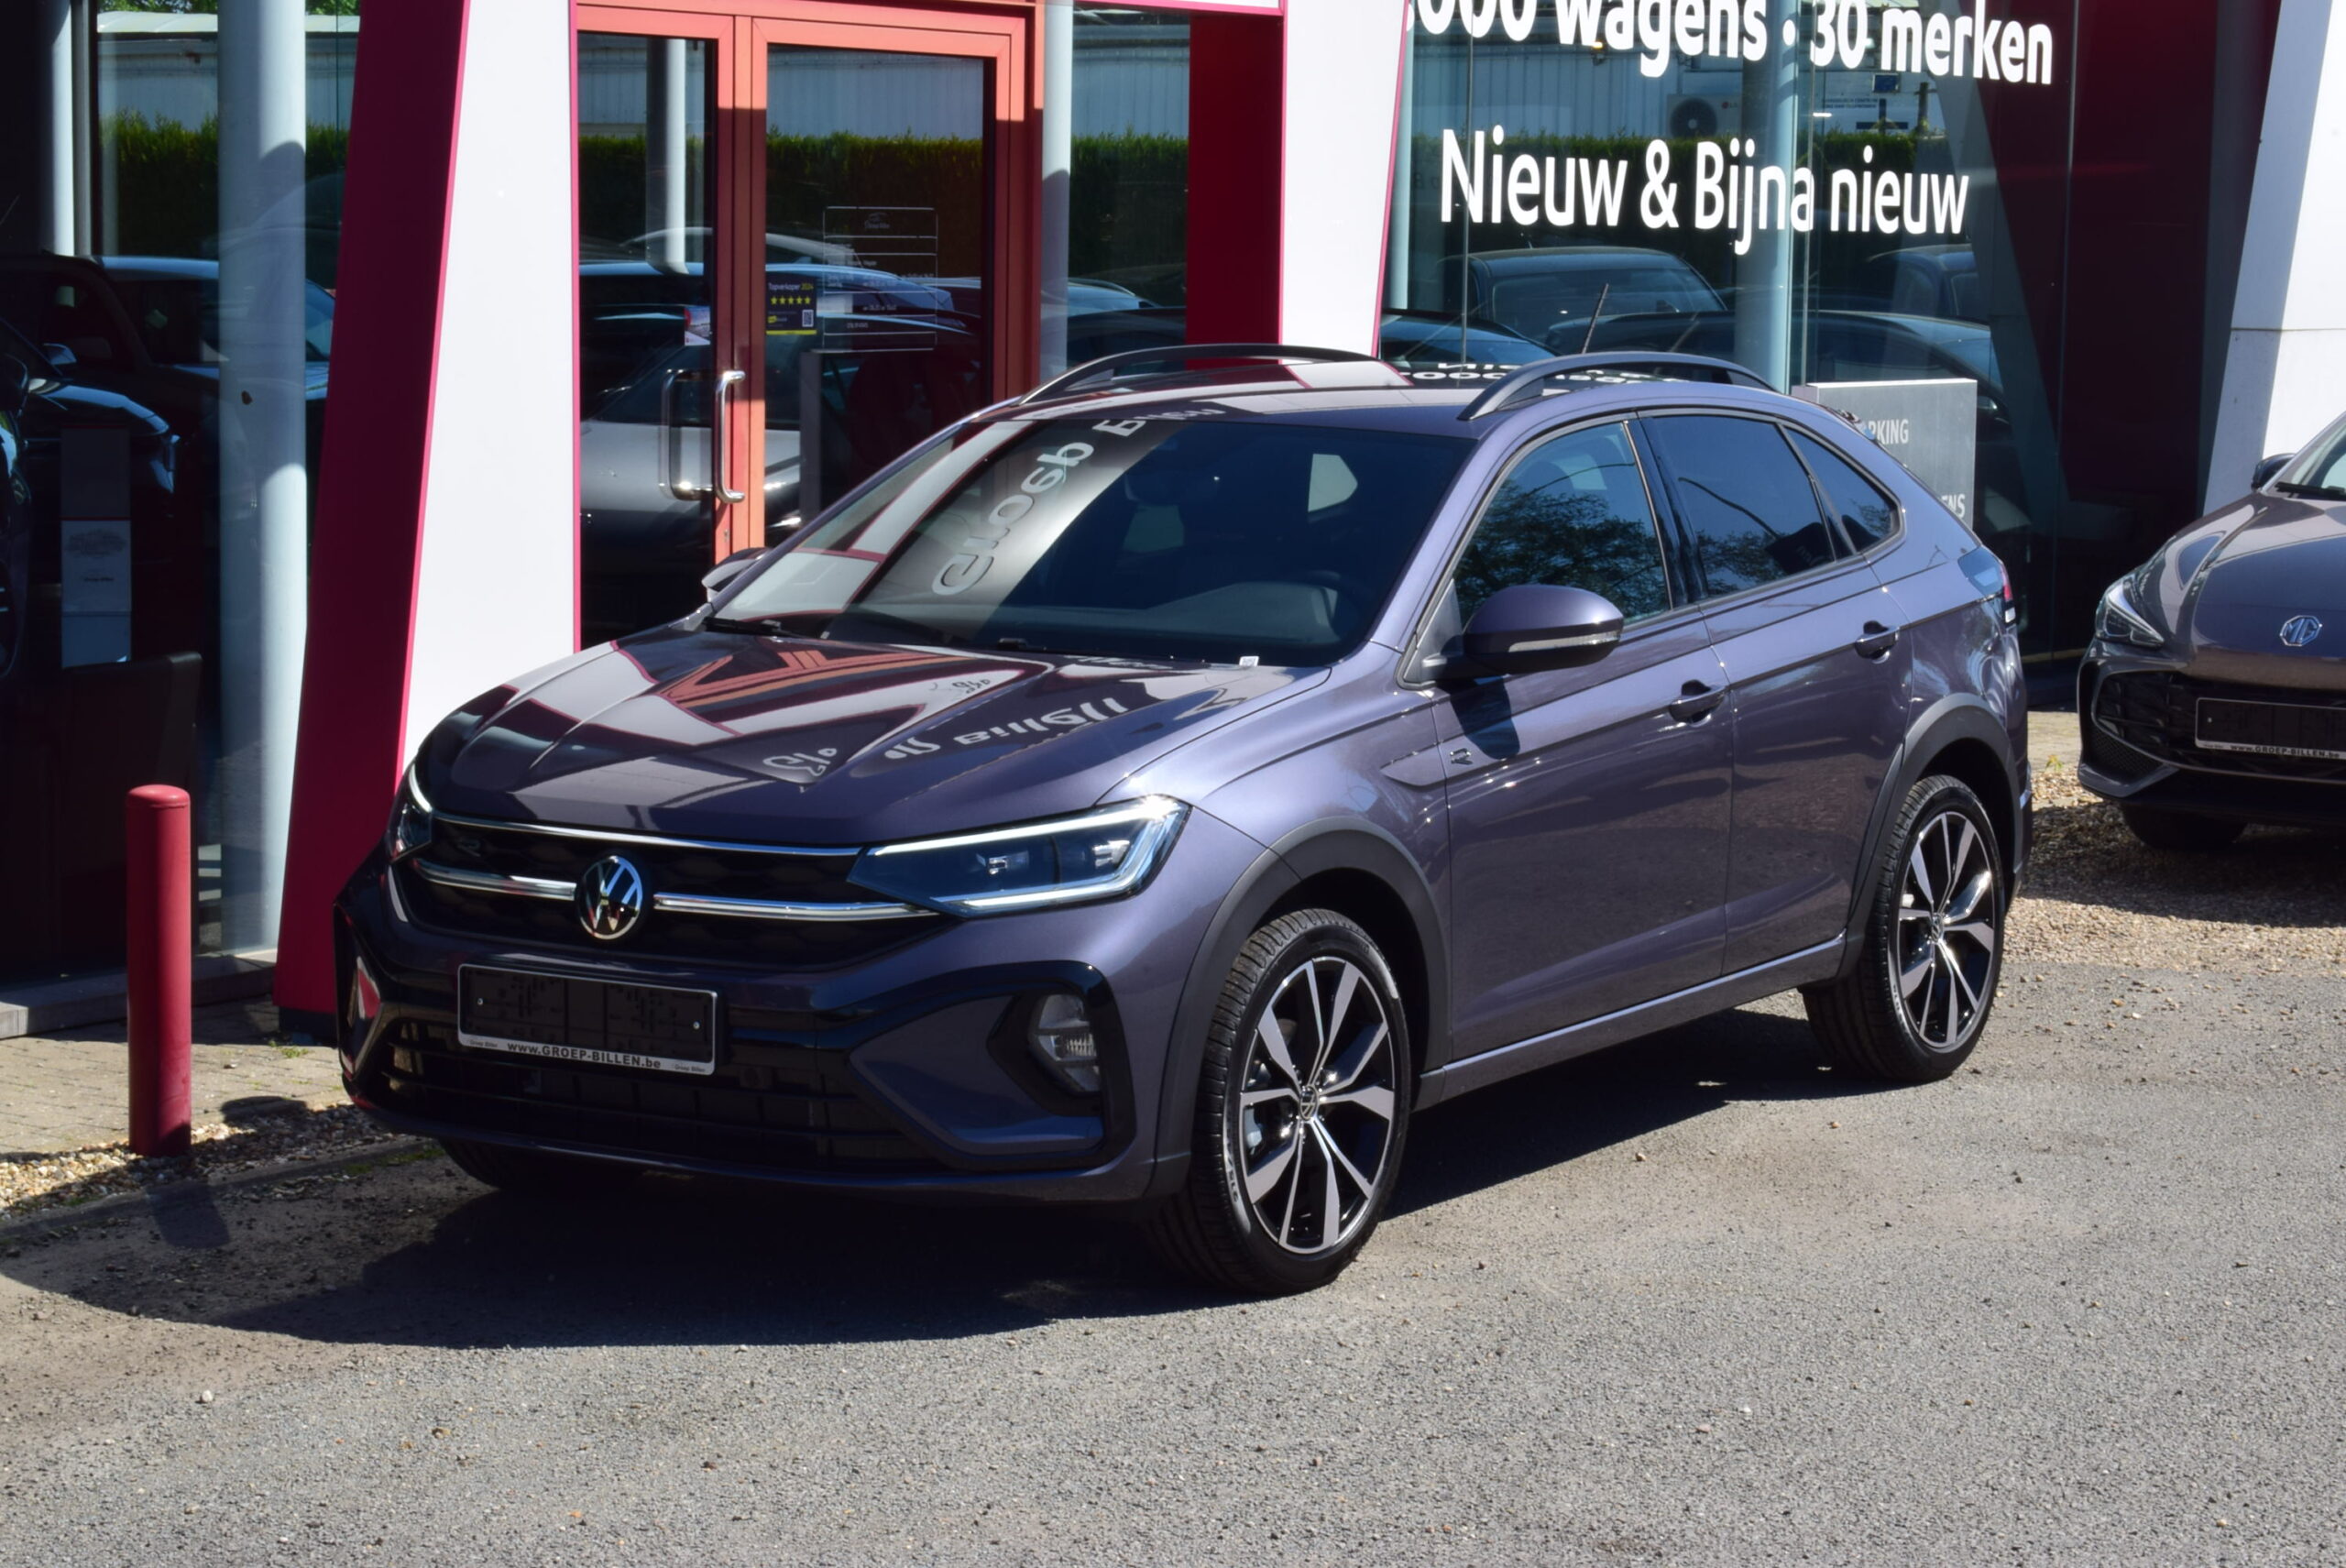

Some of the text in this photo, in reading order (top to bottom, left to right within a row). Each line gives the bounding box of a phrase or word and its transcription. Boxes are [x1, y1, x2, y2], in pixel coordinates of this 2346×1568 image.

[1555, 0, 1768, 78] wagens
[1810, 0, 1869, 69] 30
[1880, 0, 2053, 84] merken
[1442, 125, 1969, 256] Nieuw & Bijna nieuw
[2230, 744, 2341, 758] www.GROEP-BILLEN.be
[507, 1042, 662, 1069] www.GROEP-BILLEN.be
